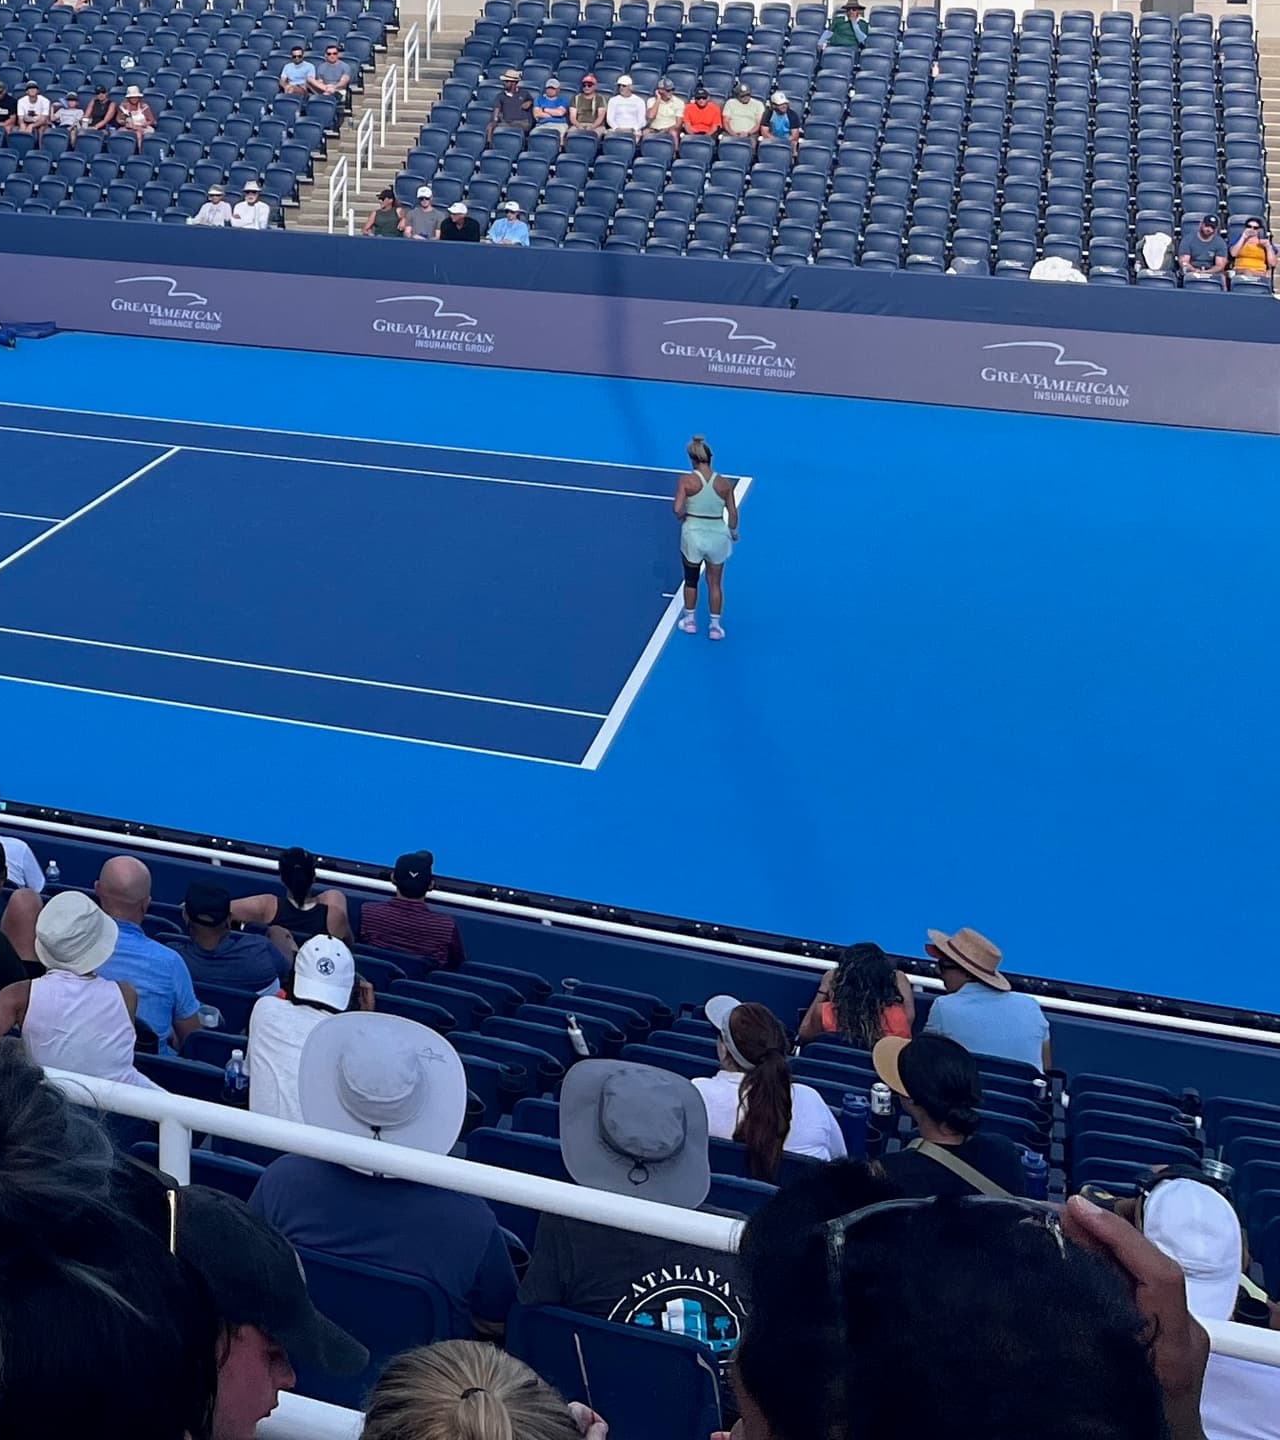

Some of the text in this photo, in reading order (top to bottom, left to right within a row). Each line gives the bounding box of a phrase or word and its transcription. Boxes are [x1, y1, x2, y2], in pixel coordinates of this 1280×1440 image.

[149, 317, 222, 332] INSURANCE GROUP
[415, 339, 494, 354] INSURANCE GROUP
[708, 362, 796, 379] INSURANCE GROUP
[1033, 390, 1129, 407] INSURANCE GROUP
[632, 1265, 730, 1298] ATALAYA
